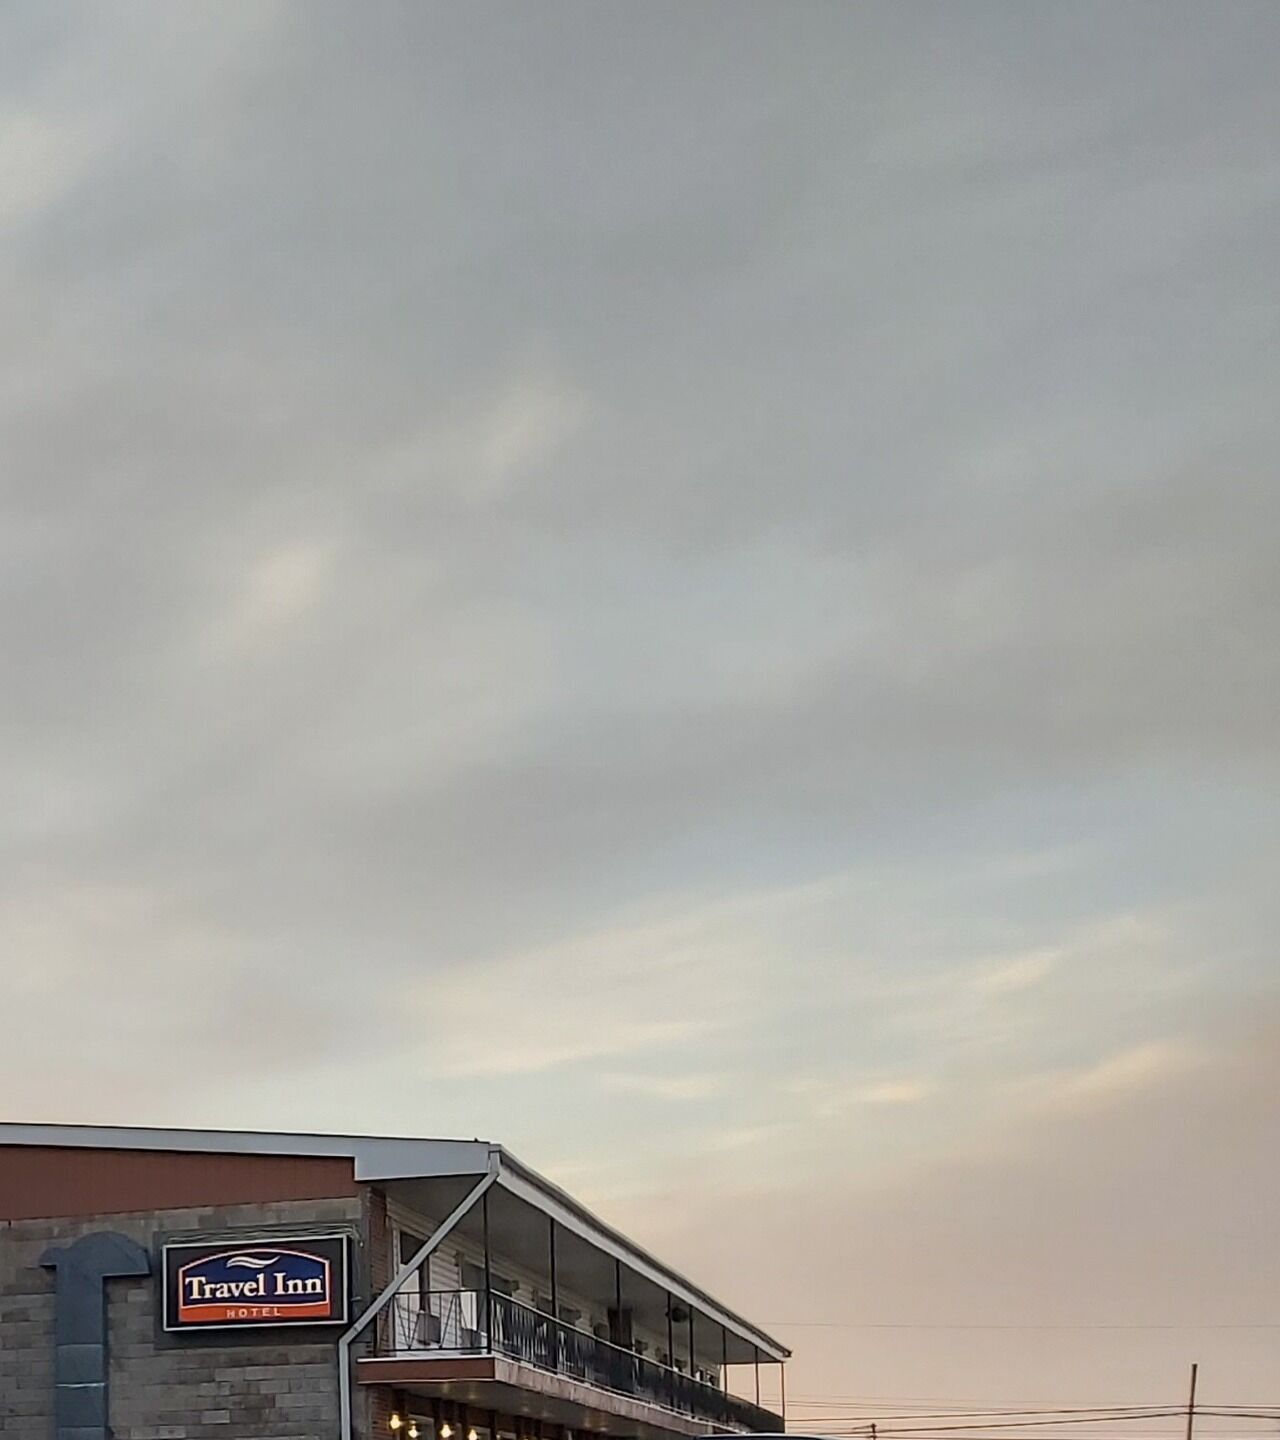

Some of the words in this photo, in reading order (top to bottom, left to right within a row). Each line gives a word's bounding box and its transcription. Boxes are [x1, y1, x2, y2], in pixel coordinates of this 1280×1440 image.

[185, 1273, 265, 1299] Travel
[274, 1272, 323, 1295] Inn
[226, 1307, 282, 1318] HOTEL
